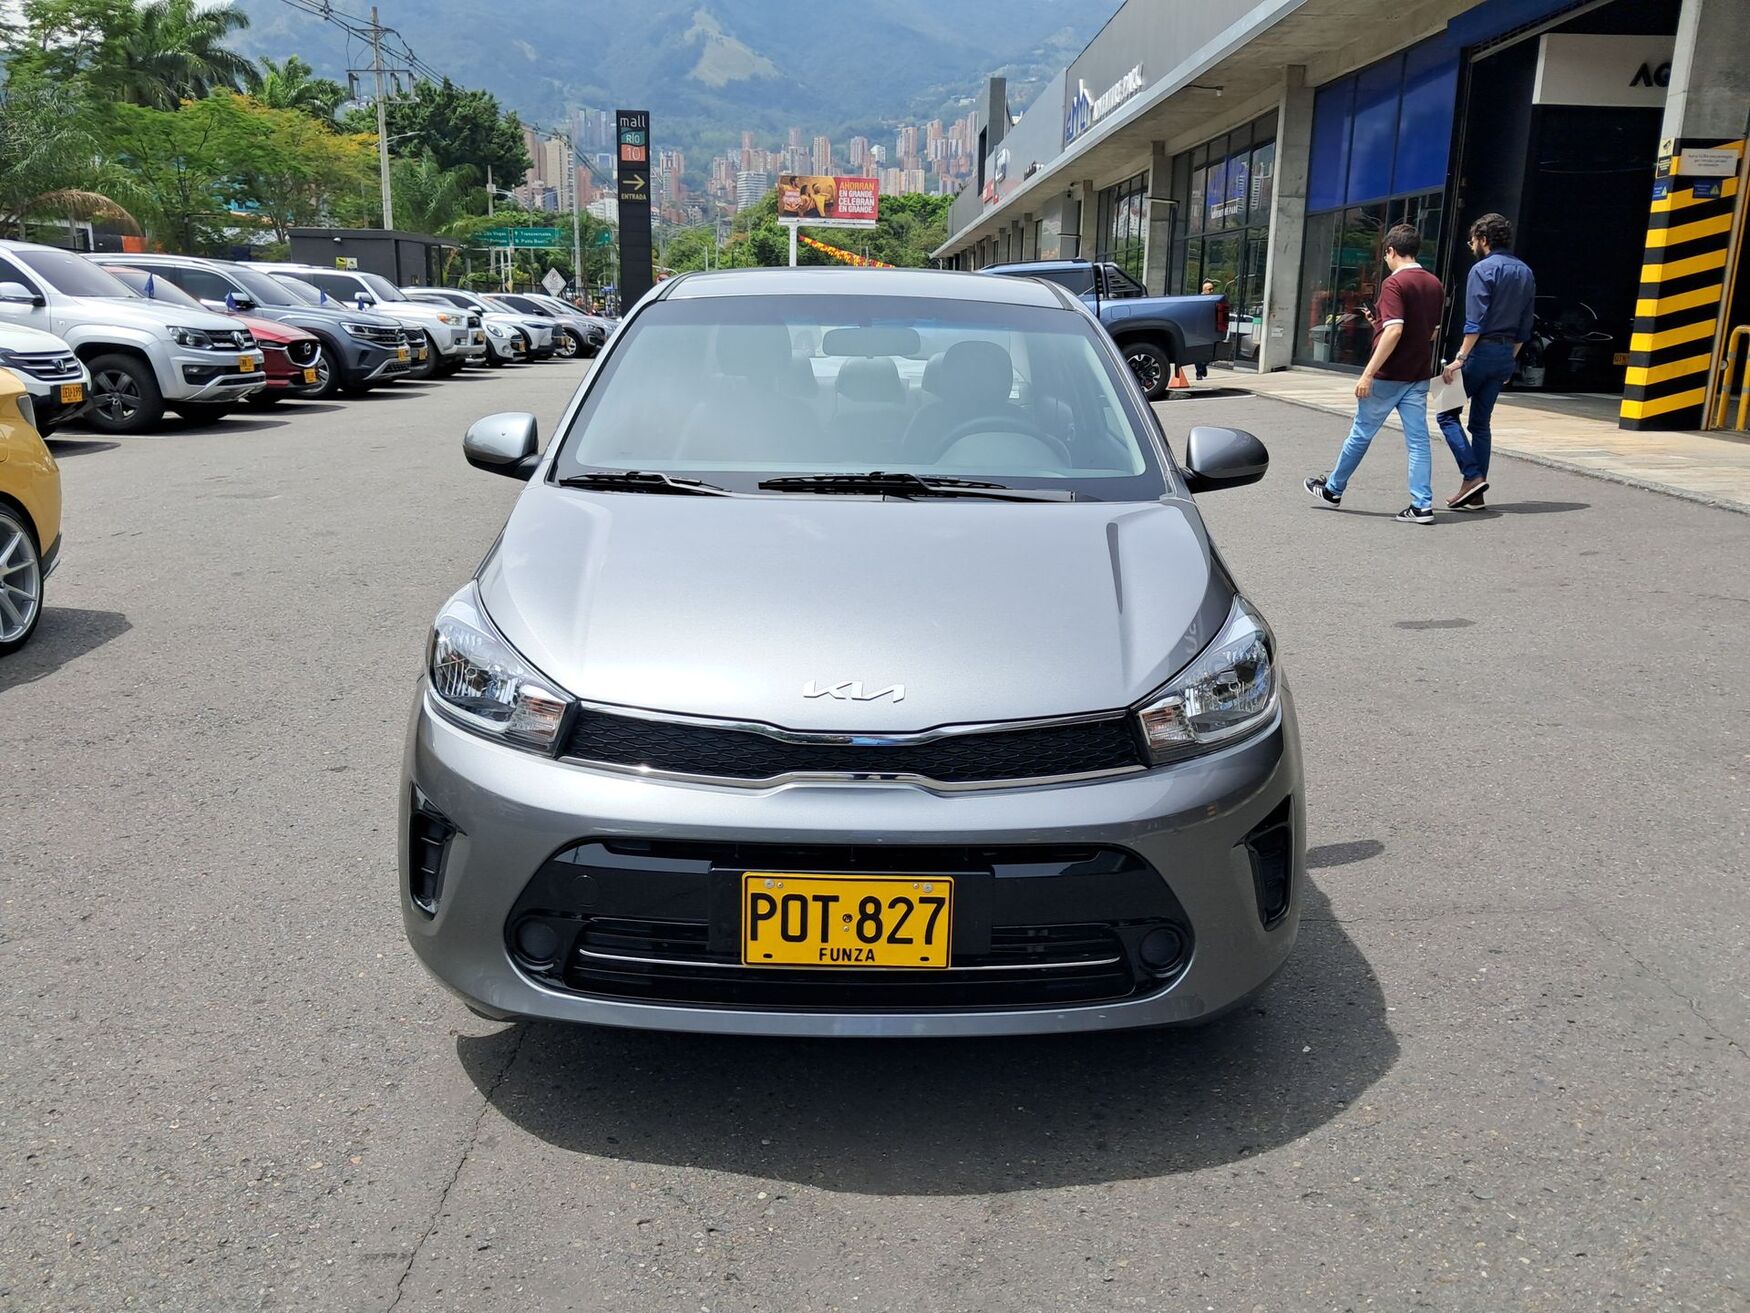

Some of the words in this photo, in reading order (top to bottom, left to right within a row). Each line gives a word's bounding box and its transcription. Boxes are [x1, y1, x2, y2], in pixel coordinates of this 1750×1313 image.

[620, 115, 646, 128] mall
[627, 147, 641, 160] 10
[840, 182, 875, 191] AHORRAN
[838, 198, 875, 206] CELEBRAN
[803, 679, 906, 704] KIA
[818, 947, 876, 962] FUNZA
